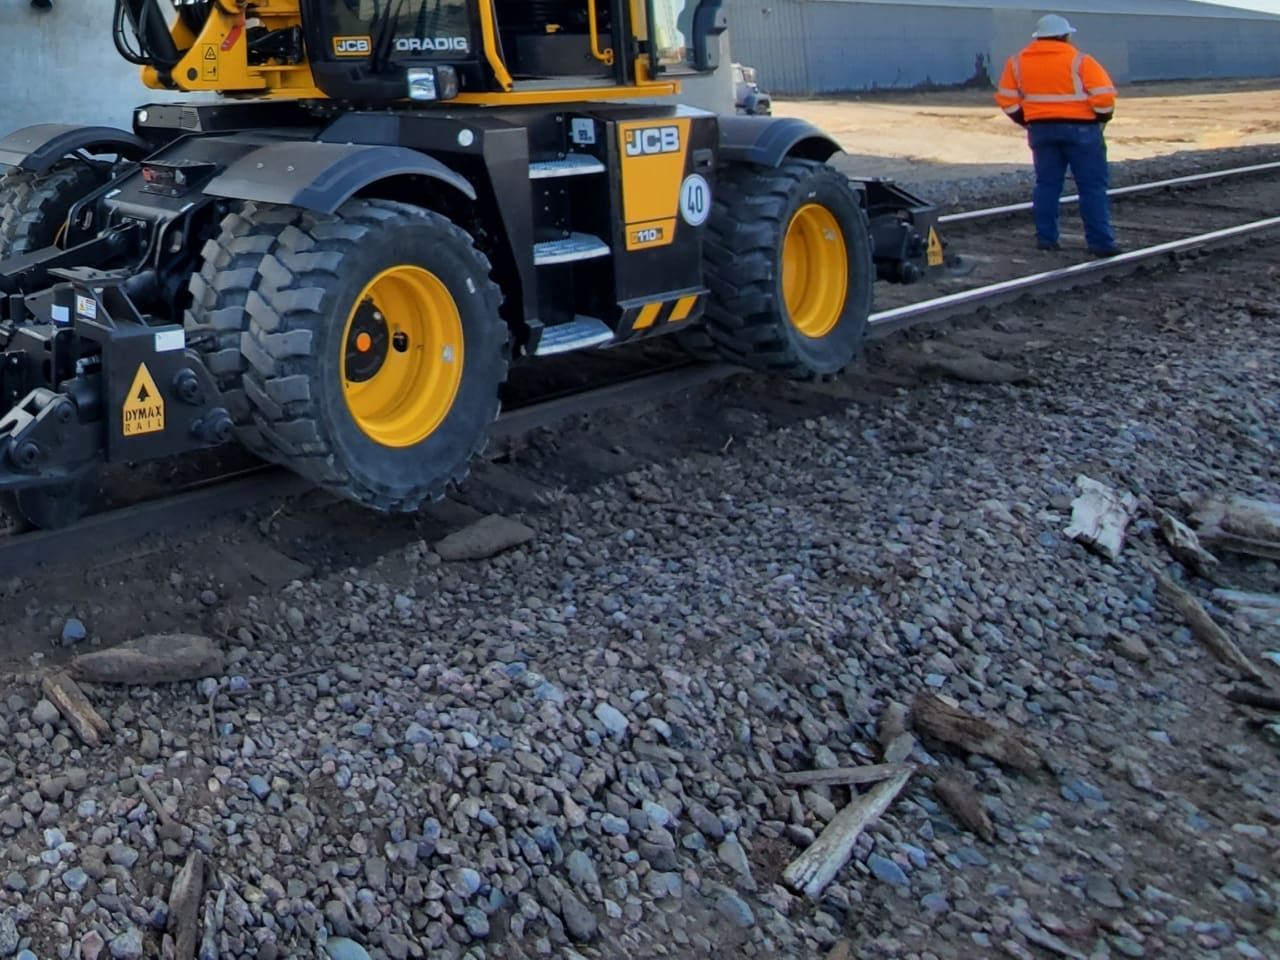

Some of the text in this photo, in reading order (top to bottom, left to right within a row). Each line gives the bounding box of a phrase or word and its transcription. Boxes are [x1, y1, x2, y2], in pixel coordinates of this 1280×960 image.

[337, 40, 369, 52] JCB
[626, 126, 679, 156] JCB
[687, 186, 703, 213] 40
[125, 406, 161, 422] DYMAX
[125, 419, 161, 432] RAIL
